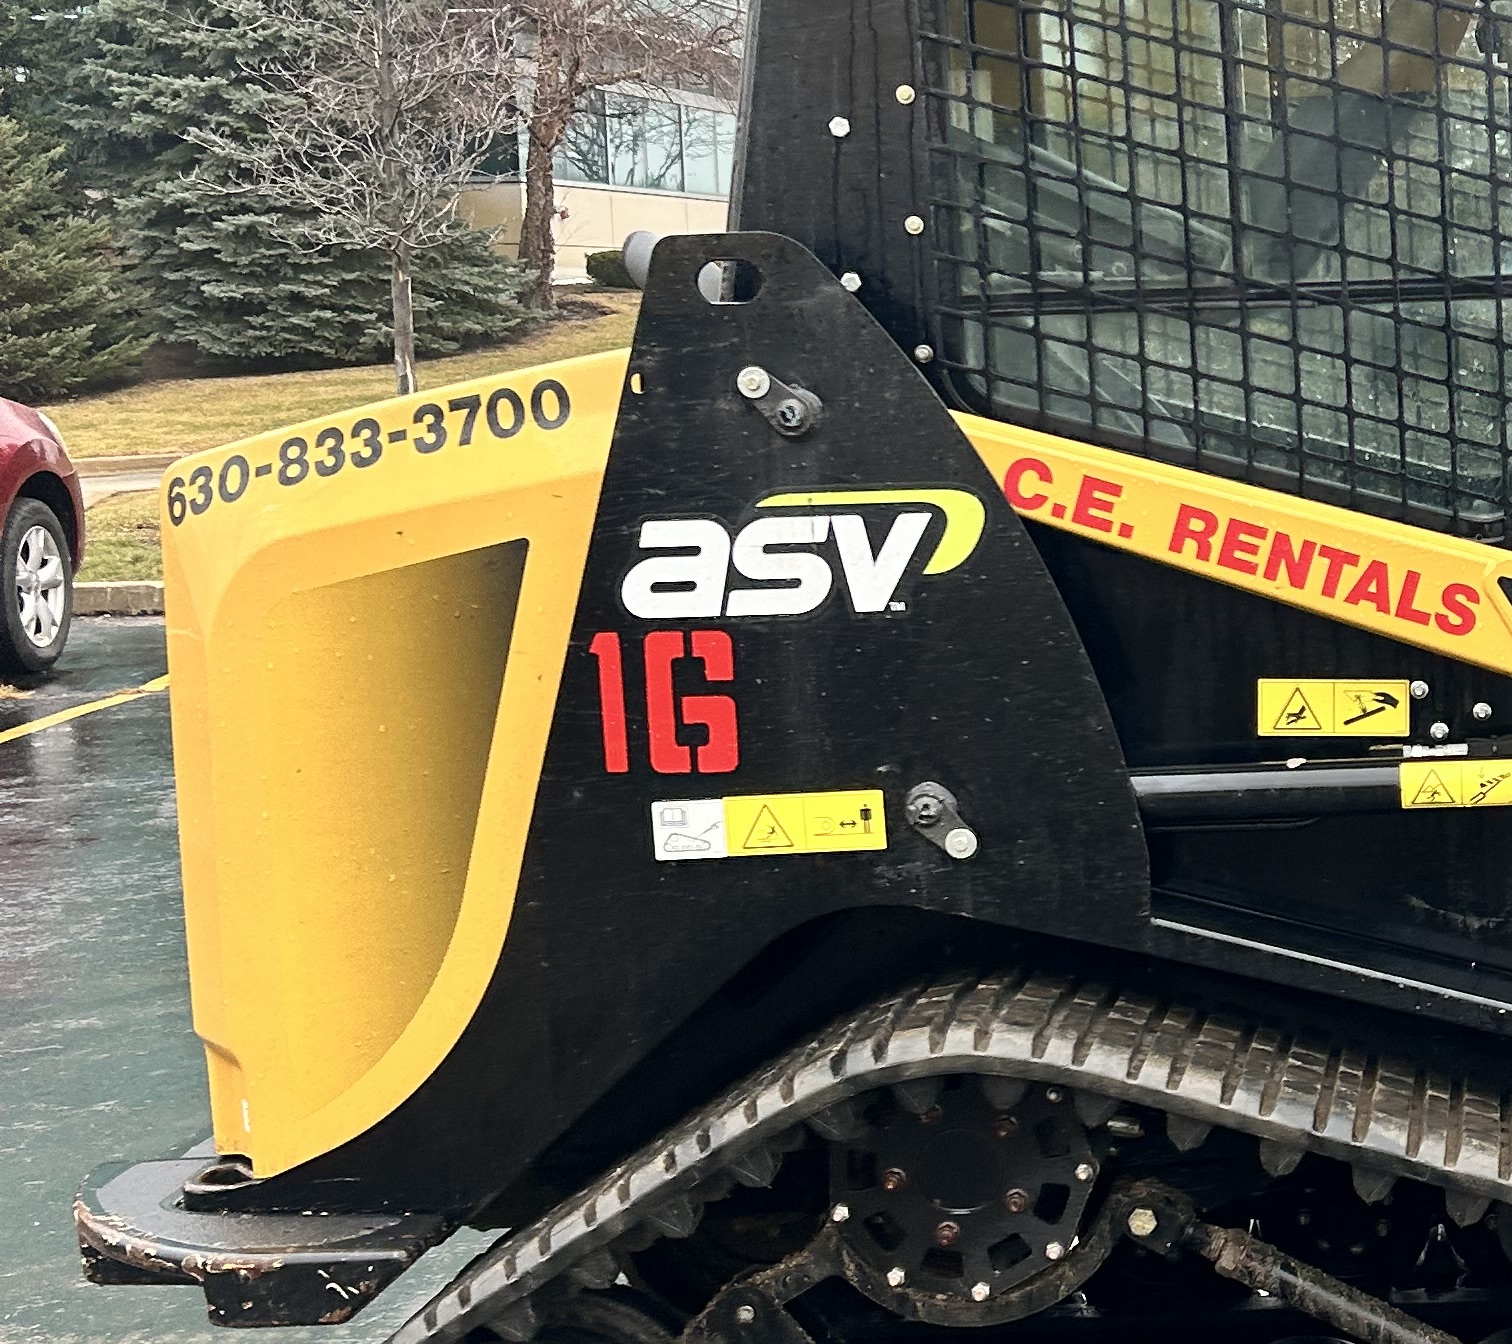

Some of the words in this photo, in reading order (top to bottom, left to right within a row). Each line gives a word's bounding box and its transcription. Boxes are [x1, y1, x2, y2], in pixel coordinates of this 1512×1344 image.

[167, 378, 571, 527] 630-833-3700
[1003, 457, 1134, 539] C.E.
[1167, 502, 1482, 637] RENTALS
